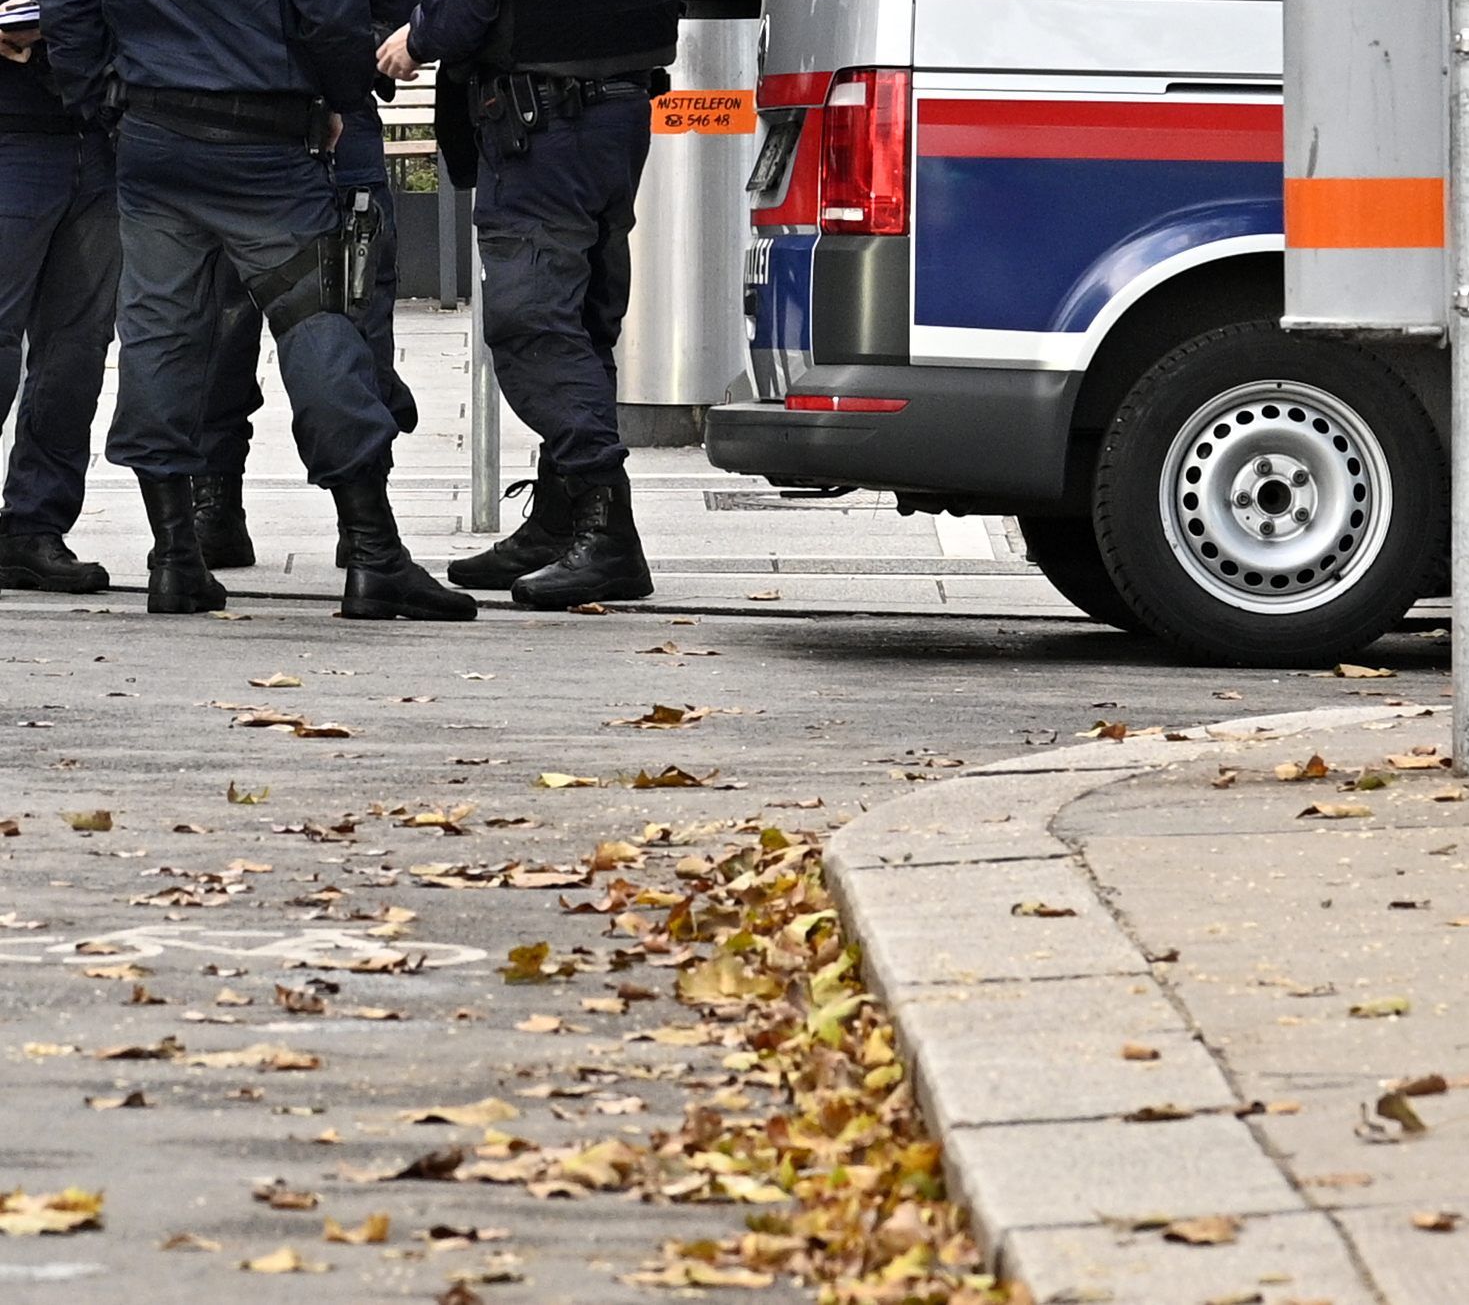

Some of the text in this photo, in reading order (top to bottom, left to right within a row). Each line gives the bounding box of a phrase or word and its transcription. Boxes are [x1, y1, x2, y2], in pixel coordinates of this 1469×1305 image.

[656, 97, 742, 110] MISTTELEFON
[687, 114, 731, 127] 546 48
